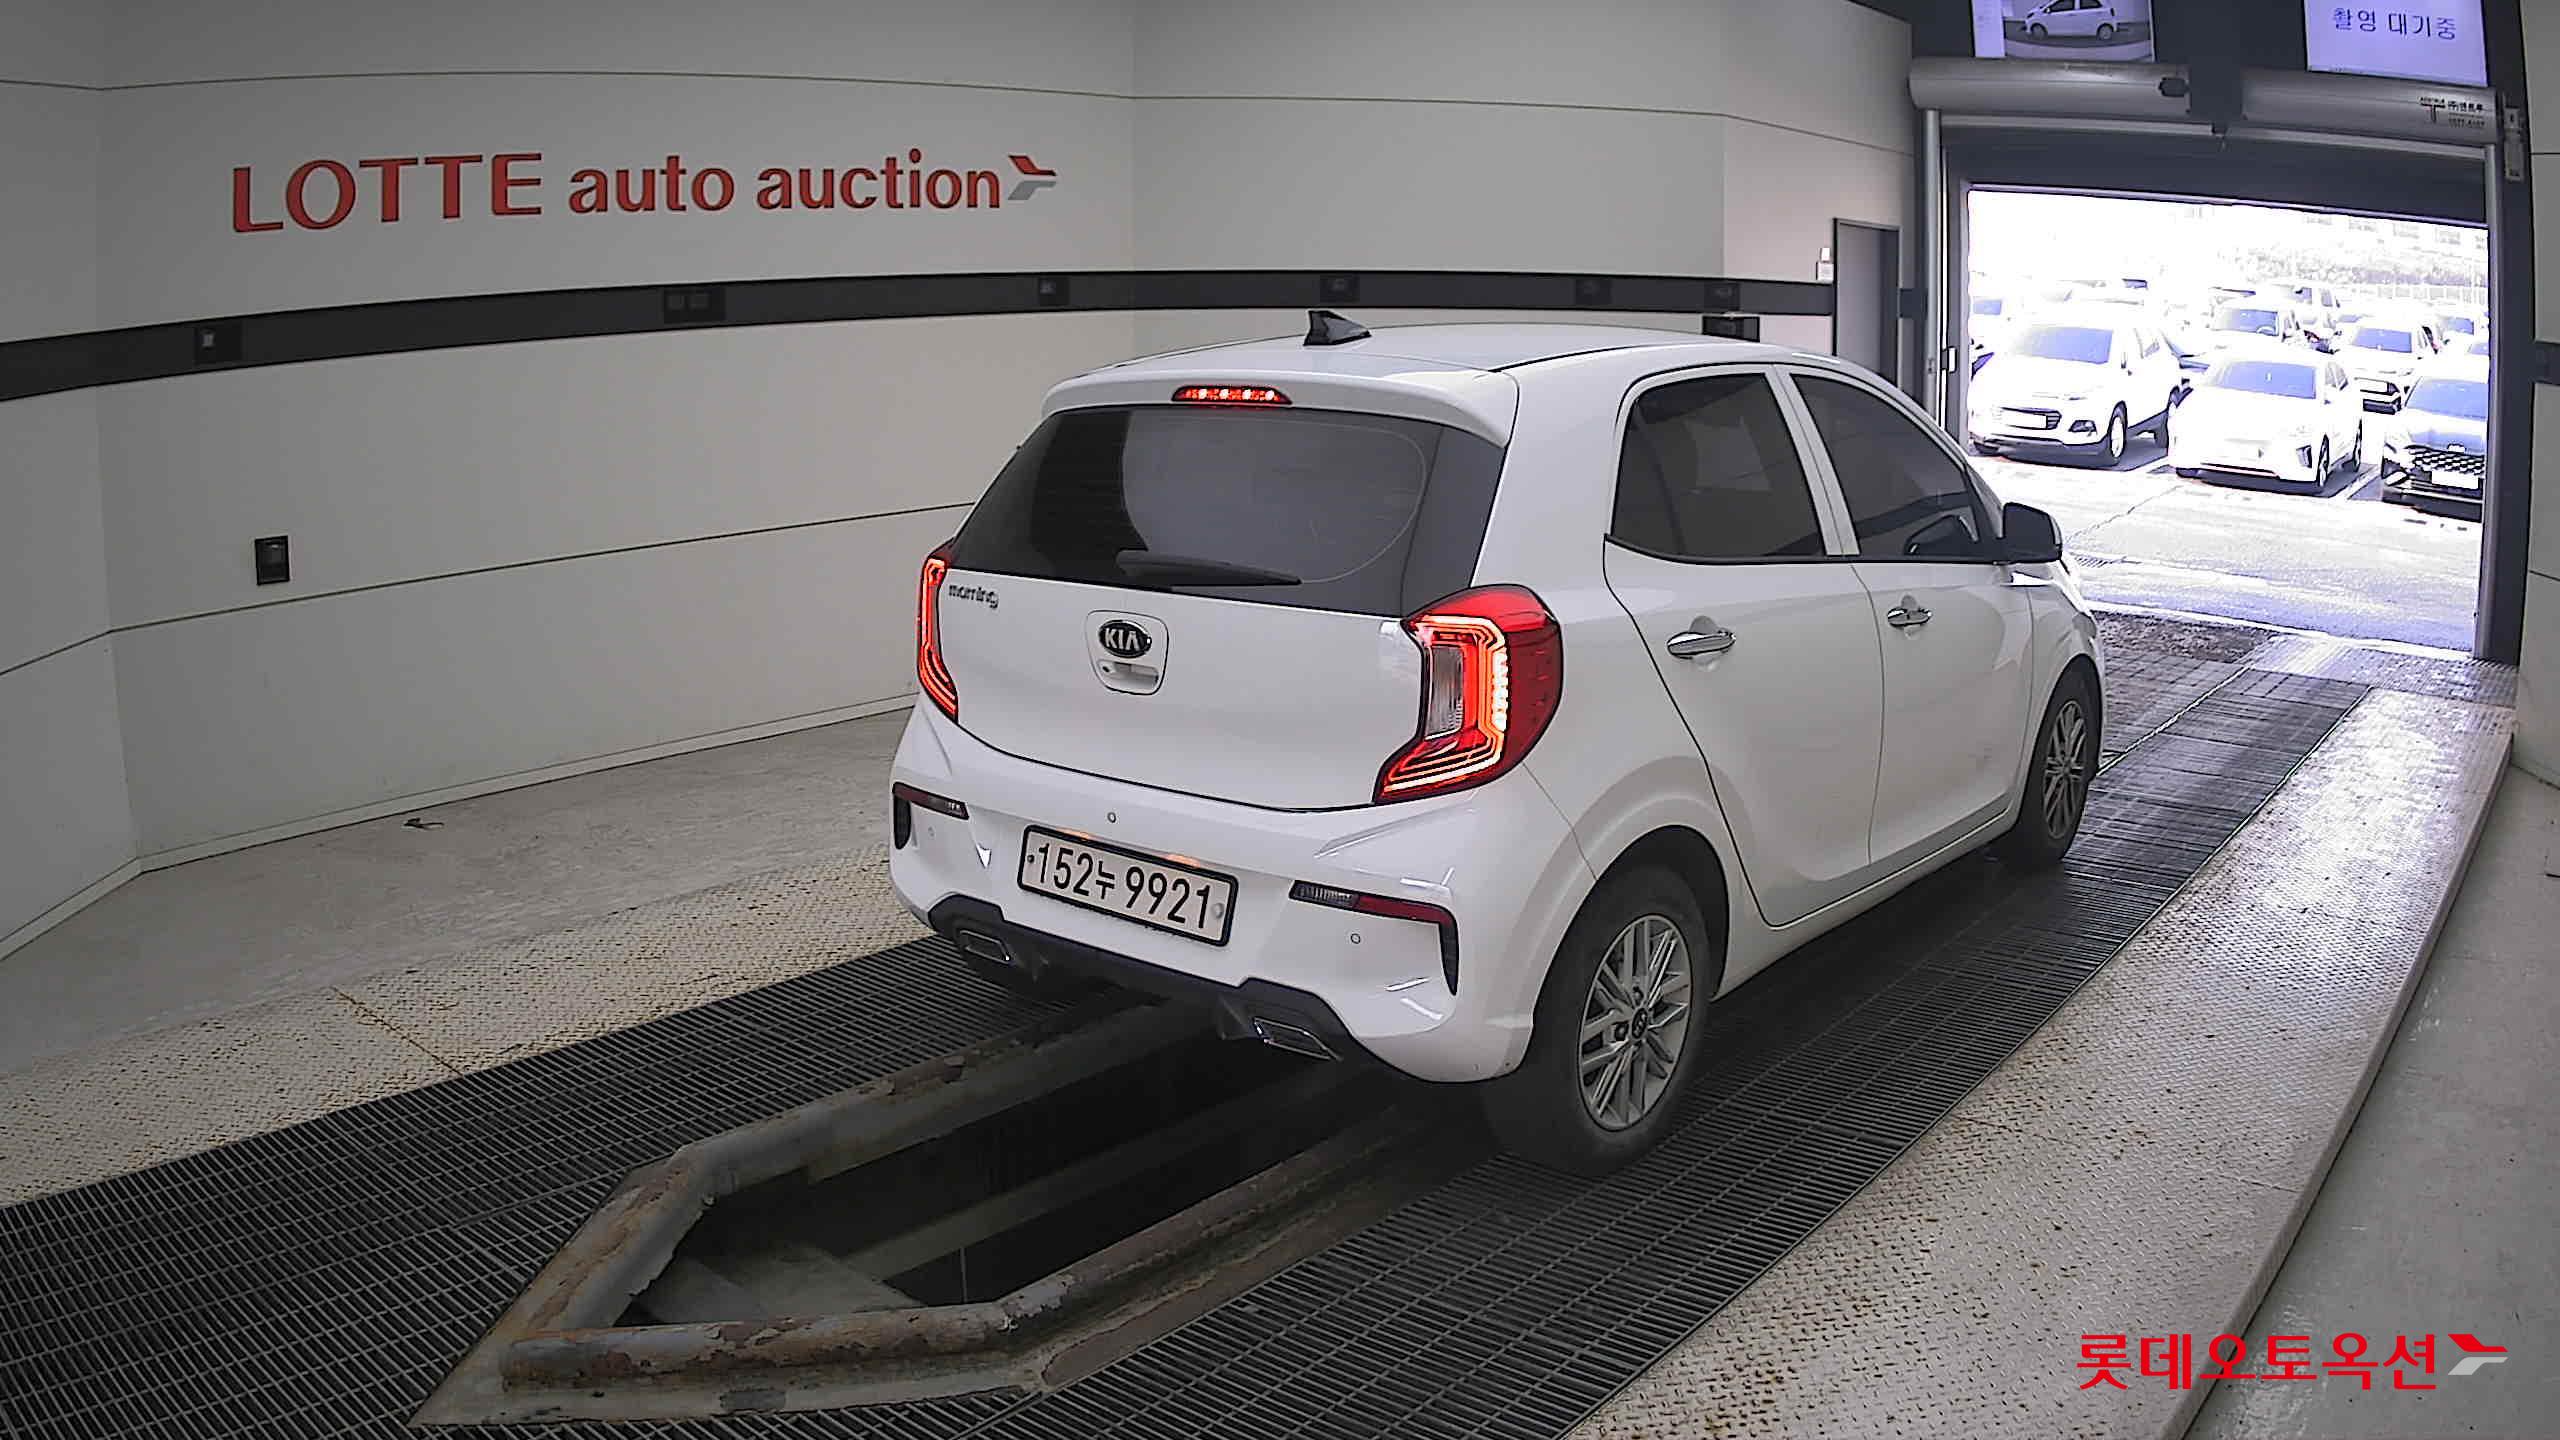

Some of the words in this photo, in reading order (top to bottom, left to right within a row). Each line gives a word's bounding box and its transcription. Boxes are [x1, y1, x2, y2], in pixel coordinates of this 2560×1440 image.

[2334, 8, 2376, 32] 촬영
[233, 152, 543, 233] LOTTE
[568, 154, 735, 213] auto
[756, 148, 1002, 211] auction
[948, 583, 1000, 609] morning
[1104, 627, 1141, 651] KIA
[1038, 842, 1115, 900] 152누
[1125, 866, 1212, 929] 9921
